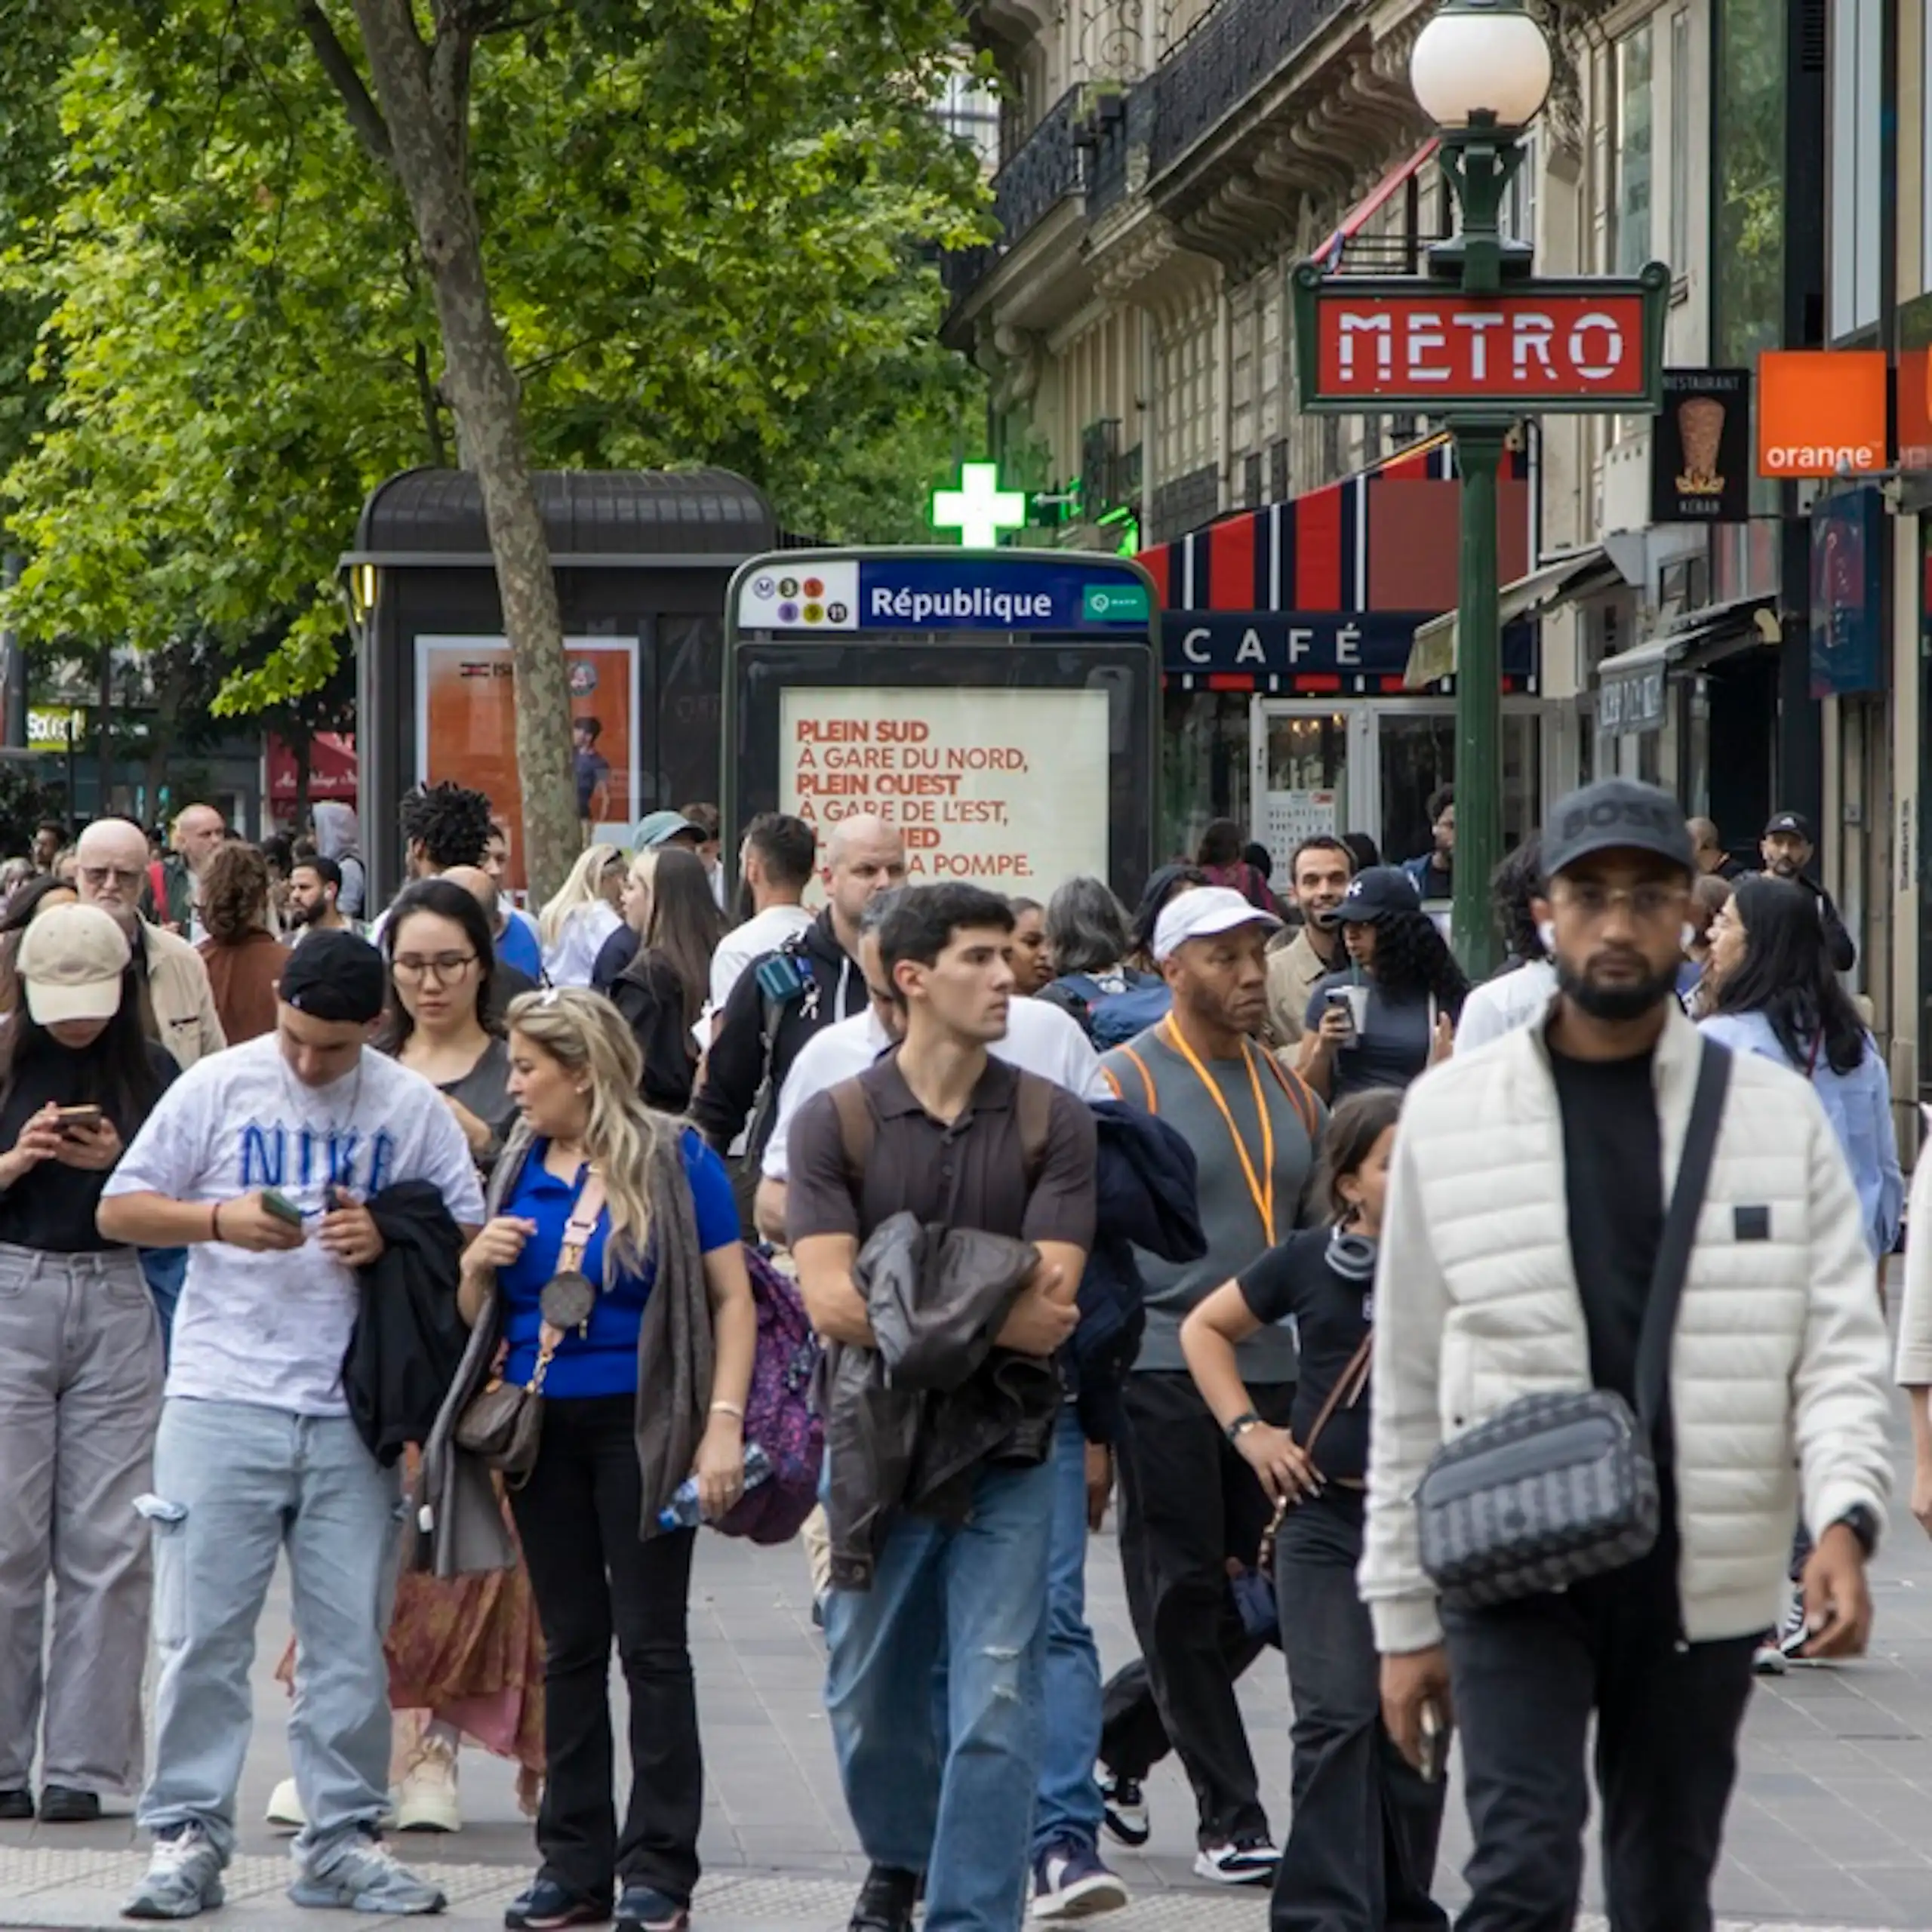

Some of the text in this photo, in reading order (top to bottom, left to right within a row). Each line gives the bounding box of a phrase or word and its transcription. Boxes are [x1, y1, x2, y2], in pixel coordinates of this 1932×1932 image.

[1340, 313, 1623, 380] METRO
[872, 586, 1052, 623] République
[1182, 623, 1362, 664] CAFÉ
[797, 720, 929, 742] PLEIN SUD
[798, 740, 1028, 772] À GARE DU NORD,
[797, 774, 961, 795] PLEIN OUEST
[823, 801, 894, 822] GARE
[903, 801, 935, 821] DE
[944, 801, 1008, 826] L'EST,
[900, 827, 941, 848] IED
[934, 854, 1033, 876] POMPE.
